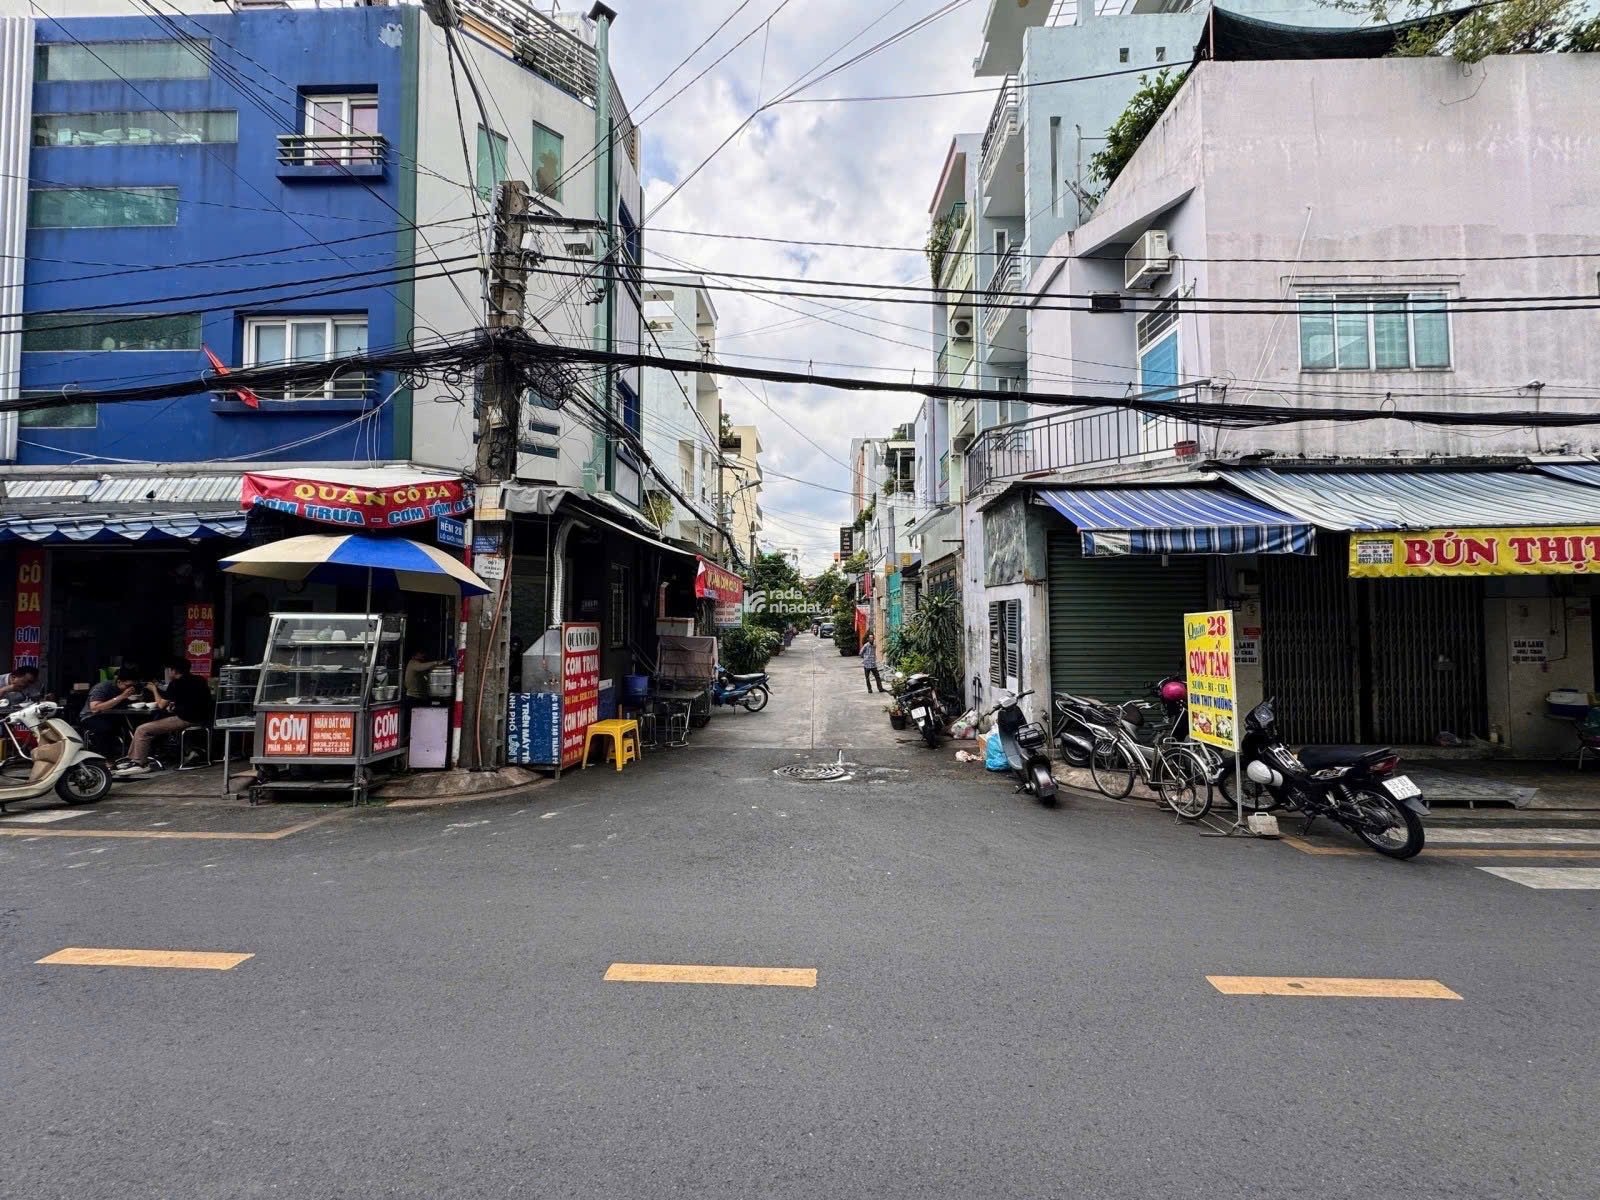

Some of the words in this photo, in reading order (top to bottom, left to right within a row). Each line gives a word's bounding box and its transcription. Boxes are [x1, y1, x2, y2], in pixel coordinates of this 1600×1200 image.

[294, 484, 386, 506] QUÁN
[393, 486, 420, 504] CÔ
[425, 485, 450, 499] BA
[304, 503, 365, 525] TRƯA
[388, 508, 425, 525] CƠM
[455, 526, 463, 536] 28
[1404, 531, 1497, 566] BÚN
[18, 560, 41, 584] CÔ
[17, 593, 40, 611] BA
[201, 607, 213, 619] BA
[16, 625, 40, 643] CƠM
[1207, 615, 1227, 636] 28
[1189, 648, 1207, 676] CƠM
[1208, 640, 1230, 678] TẤM
[268, 714, 307, 741] CƠM
[374, 711, 398, 739] CƠM
[509, 711, 518, 731] PHỐ
[522, 729, 531, 751] MÁY
